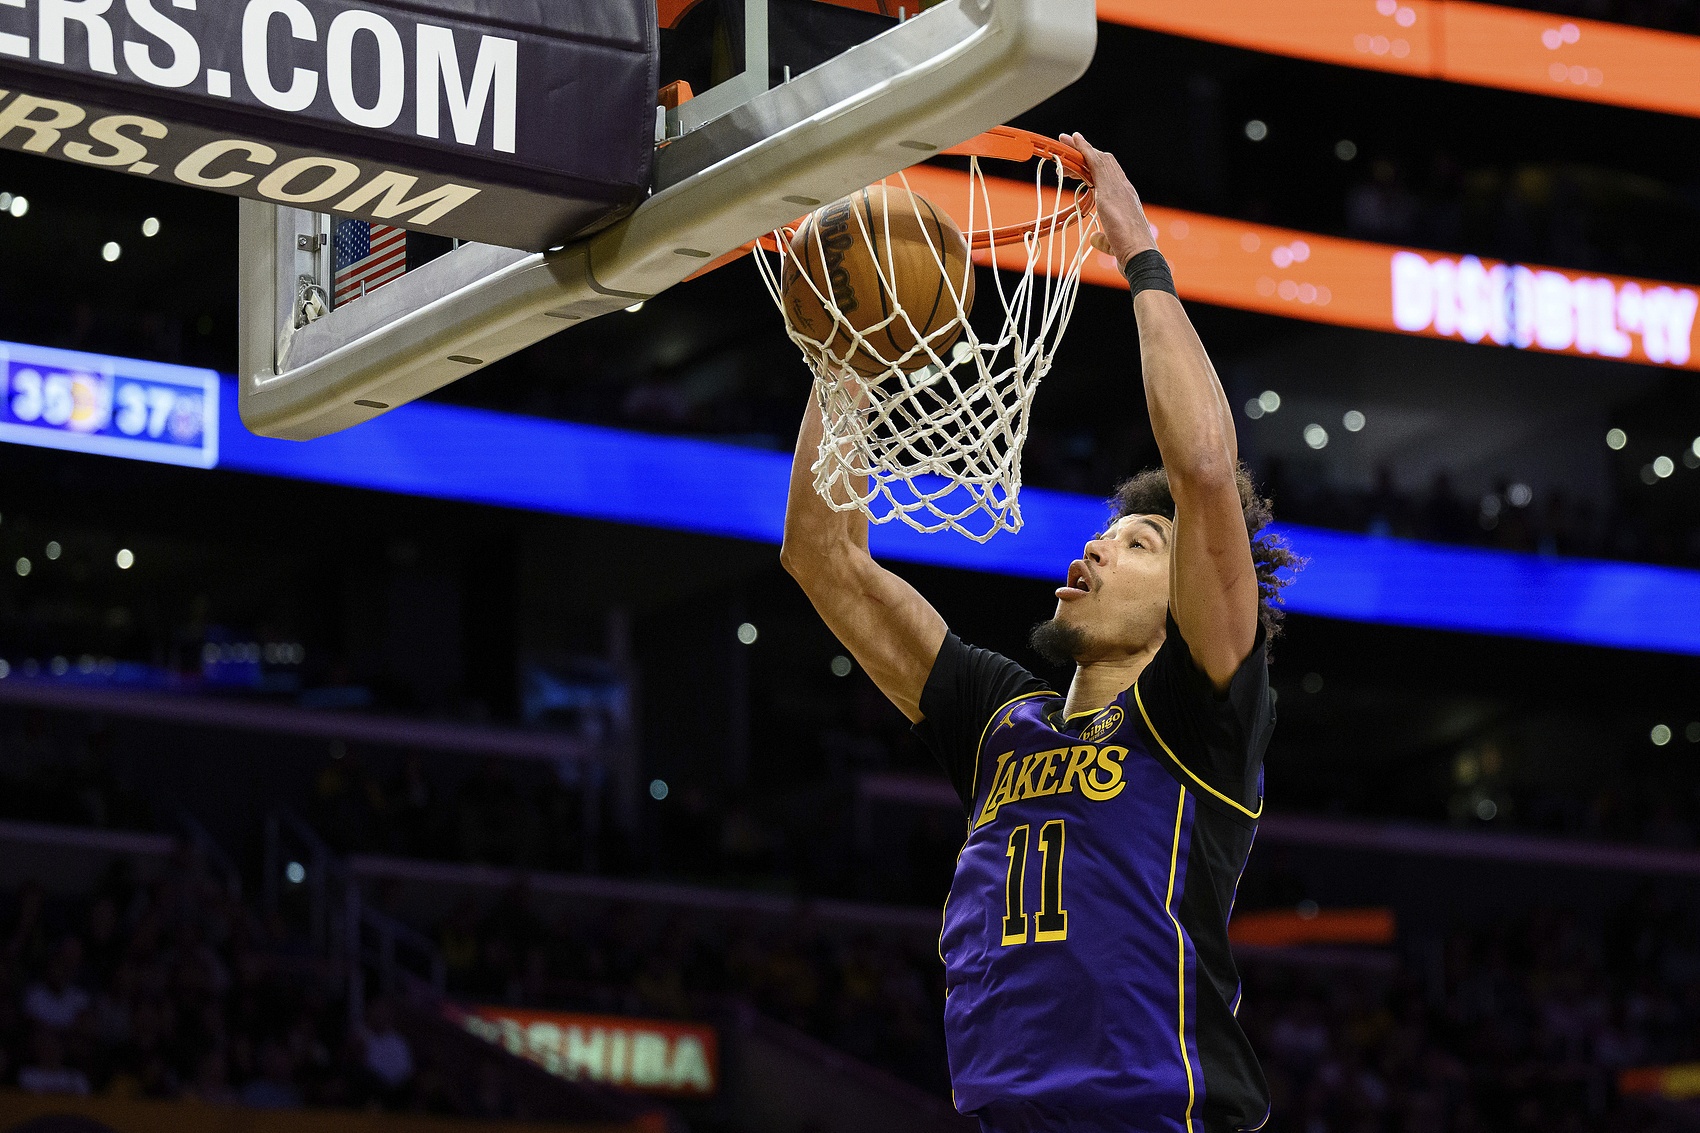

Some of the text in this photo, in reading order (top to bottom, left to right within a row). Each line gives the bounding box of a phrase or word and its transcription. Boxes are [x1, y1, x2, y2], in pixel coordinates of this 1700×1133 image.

[0, 0, 517, 153] RS.COM
[0, 89, 481, 225] RS.COM
[114, 383, 176, 439] 37
[1082, 713, 1121, 742] bibigo
[974, 744, 1130, 830] LAKERS
[1001, 819, 1068, 946] 11
